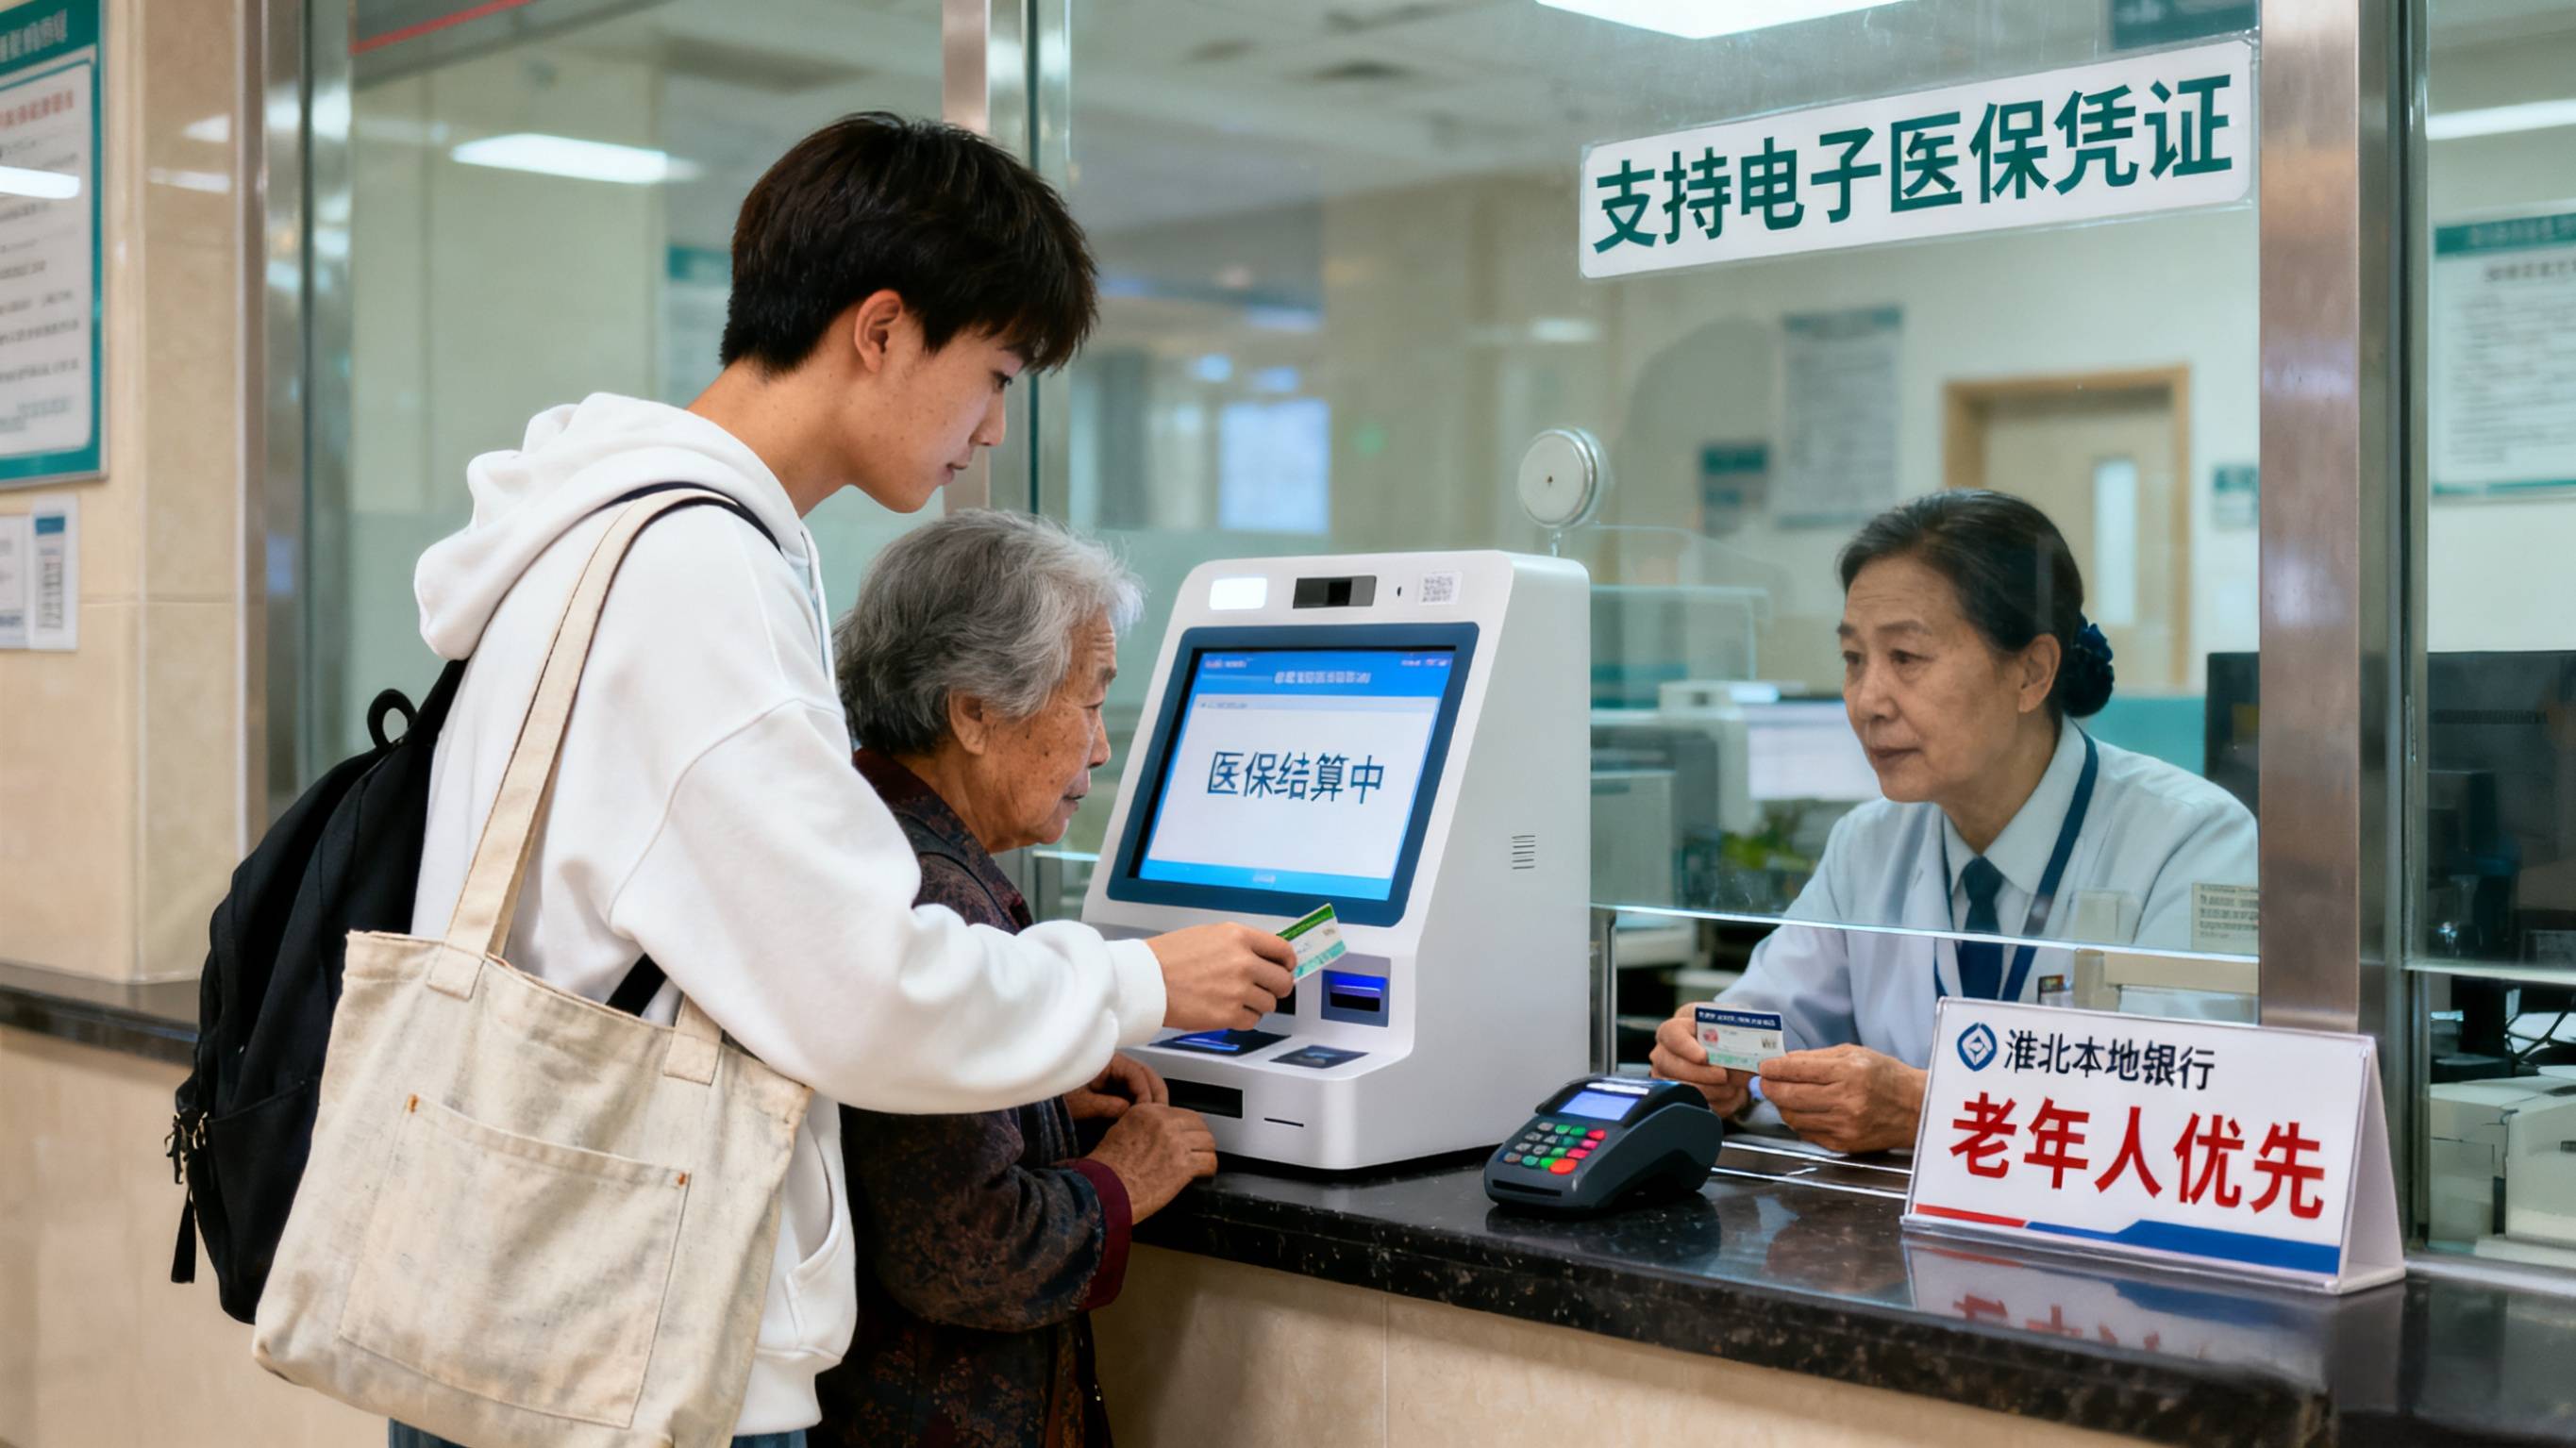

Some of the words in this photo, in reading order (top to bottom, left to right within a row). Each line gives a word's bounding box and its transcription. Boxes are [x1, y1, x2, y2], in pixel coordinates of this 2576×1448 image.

[1593, 75, 2233, 254] 支持电子医保凭证
[1207, 751, 1384, 805] 医保结算中
[2004, 1029, 2216, 1090] 淮北本地银行
[1949, 1091, 2326, 1220] 老年人优先
